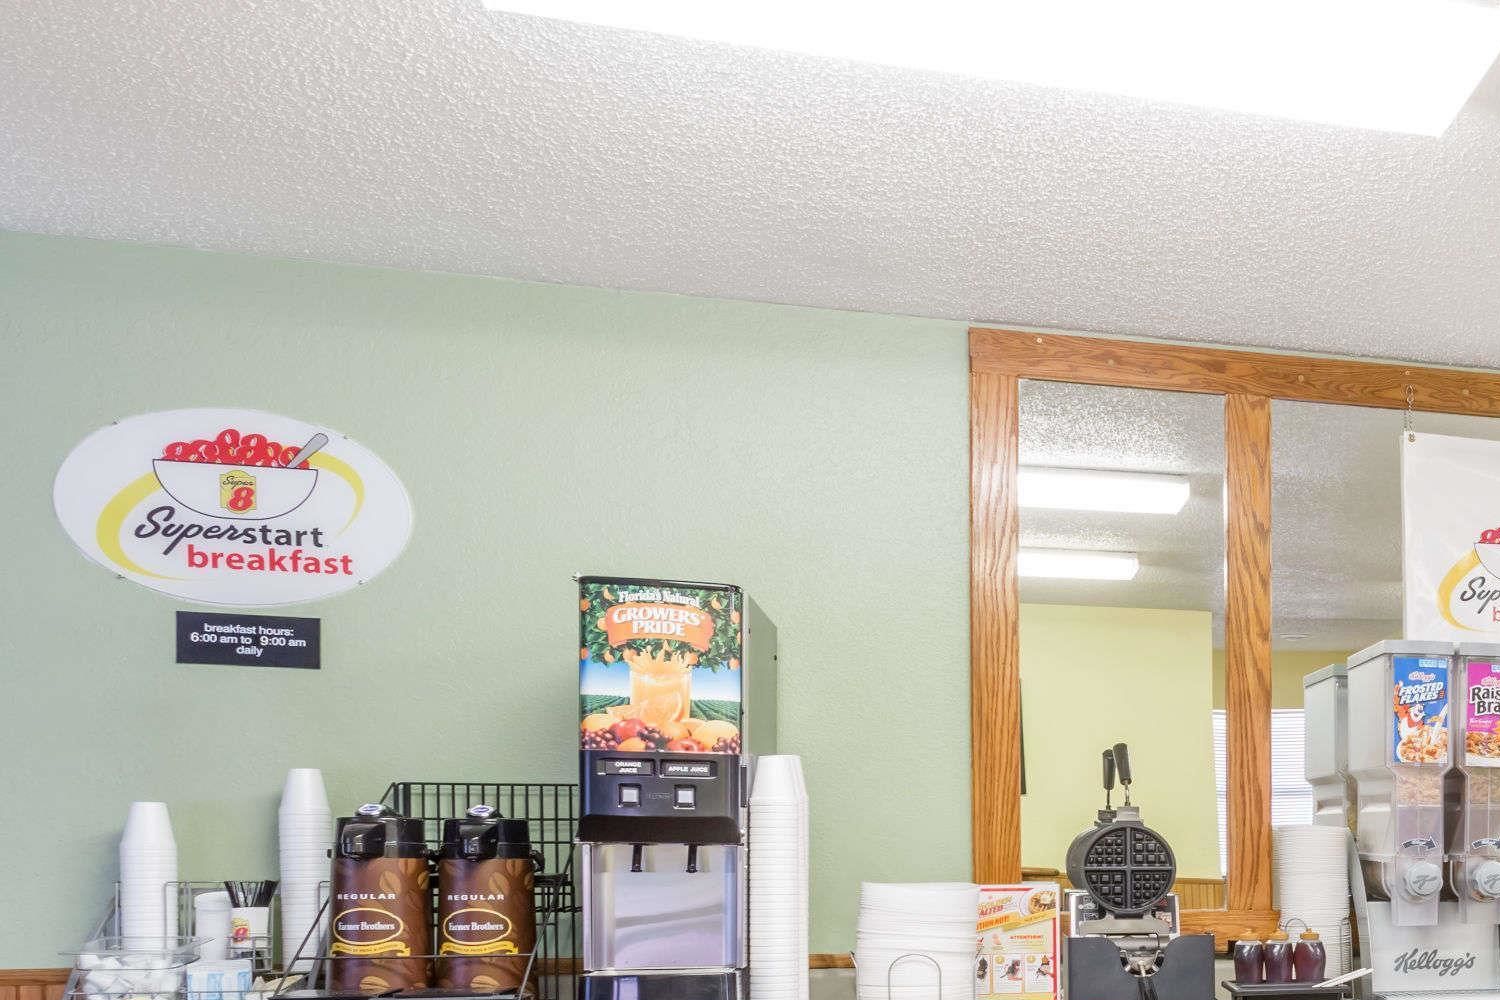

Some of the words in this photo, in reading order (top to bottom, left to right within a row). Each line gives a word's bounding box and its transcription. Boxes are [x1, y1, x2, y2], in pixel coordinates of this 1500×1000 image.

[228, 486, 255, 511] 8
[134, 505, 324, 556] Superstart
[186, 543, 354, 576] breakfast
[618, 588, 661, 603] Florida's
[662, 591, 701, 608] Natural
[203, 622, 258, 635] breakfast
[258, 625, 294, 637] hours:
[631, 619, 686, 637] PRIDE
[190, 631, 218, 643] 6:00
[219, 635, 238, 644] am
[240, 635, 252, 645] to
[259, 635, 286, 647] 9:00
[288, 638, 307, 648] am
[236, 645, 264, 658] daily
[1399, 682, 1444, 696] FROSTED
[1399, 691, 1439, 705] FLAKES
[337, 892, 397, 901] REGULAR
[447, 893, 505, 901] REGULAR
[360, 919, 396, 932] Brothers
[470, 920, 505, 932] Brothers
[1393, 946, 1477, 977] Kellogg's
